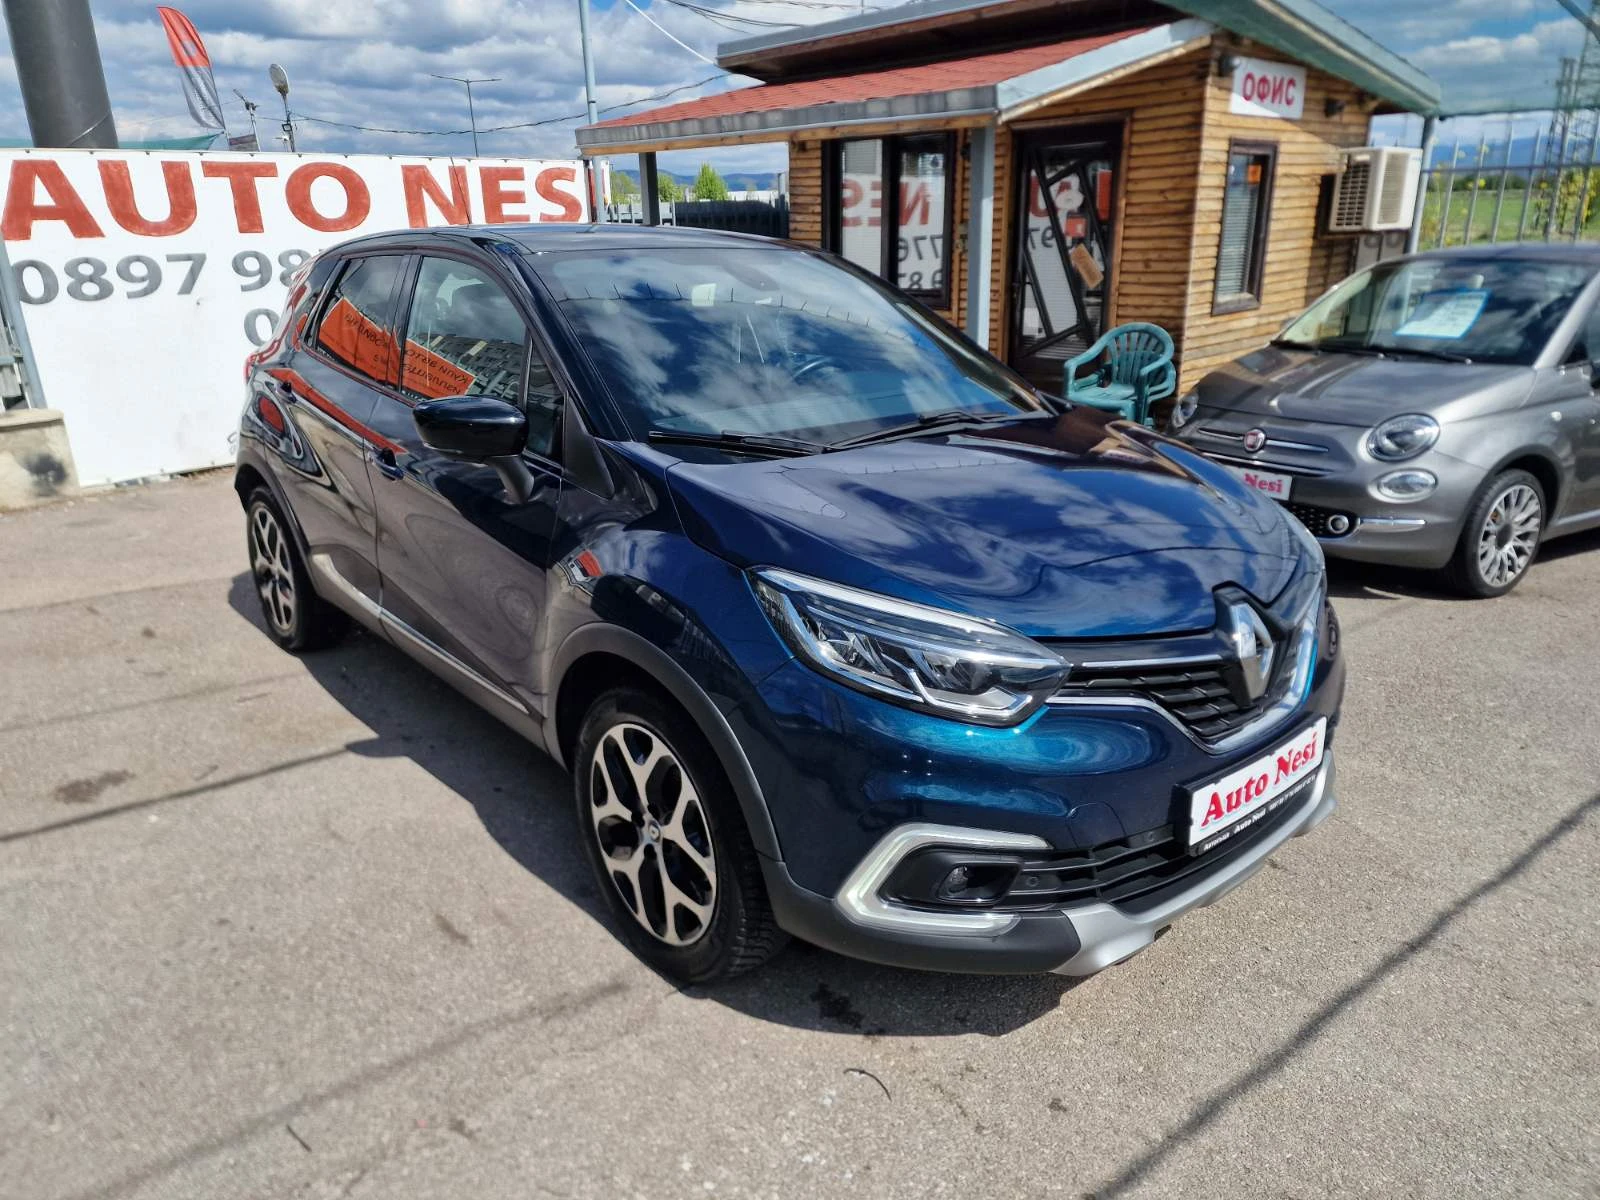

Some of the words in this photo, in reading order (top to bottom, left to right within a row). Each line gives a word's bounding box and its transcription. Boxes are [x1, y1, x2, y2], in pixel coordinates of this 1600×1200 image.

[1242, 71, 1297, 106] ОФИС
[1, 159, 371, 240] AUTO
[11, 252, 208, 306] 0897
[1244, 472, 1283, 494] Nesi
[1200, 771, 1270, 828] Auto
[1273, 731, 1318, 786] Nesi
